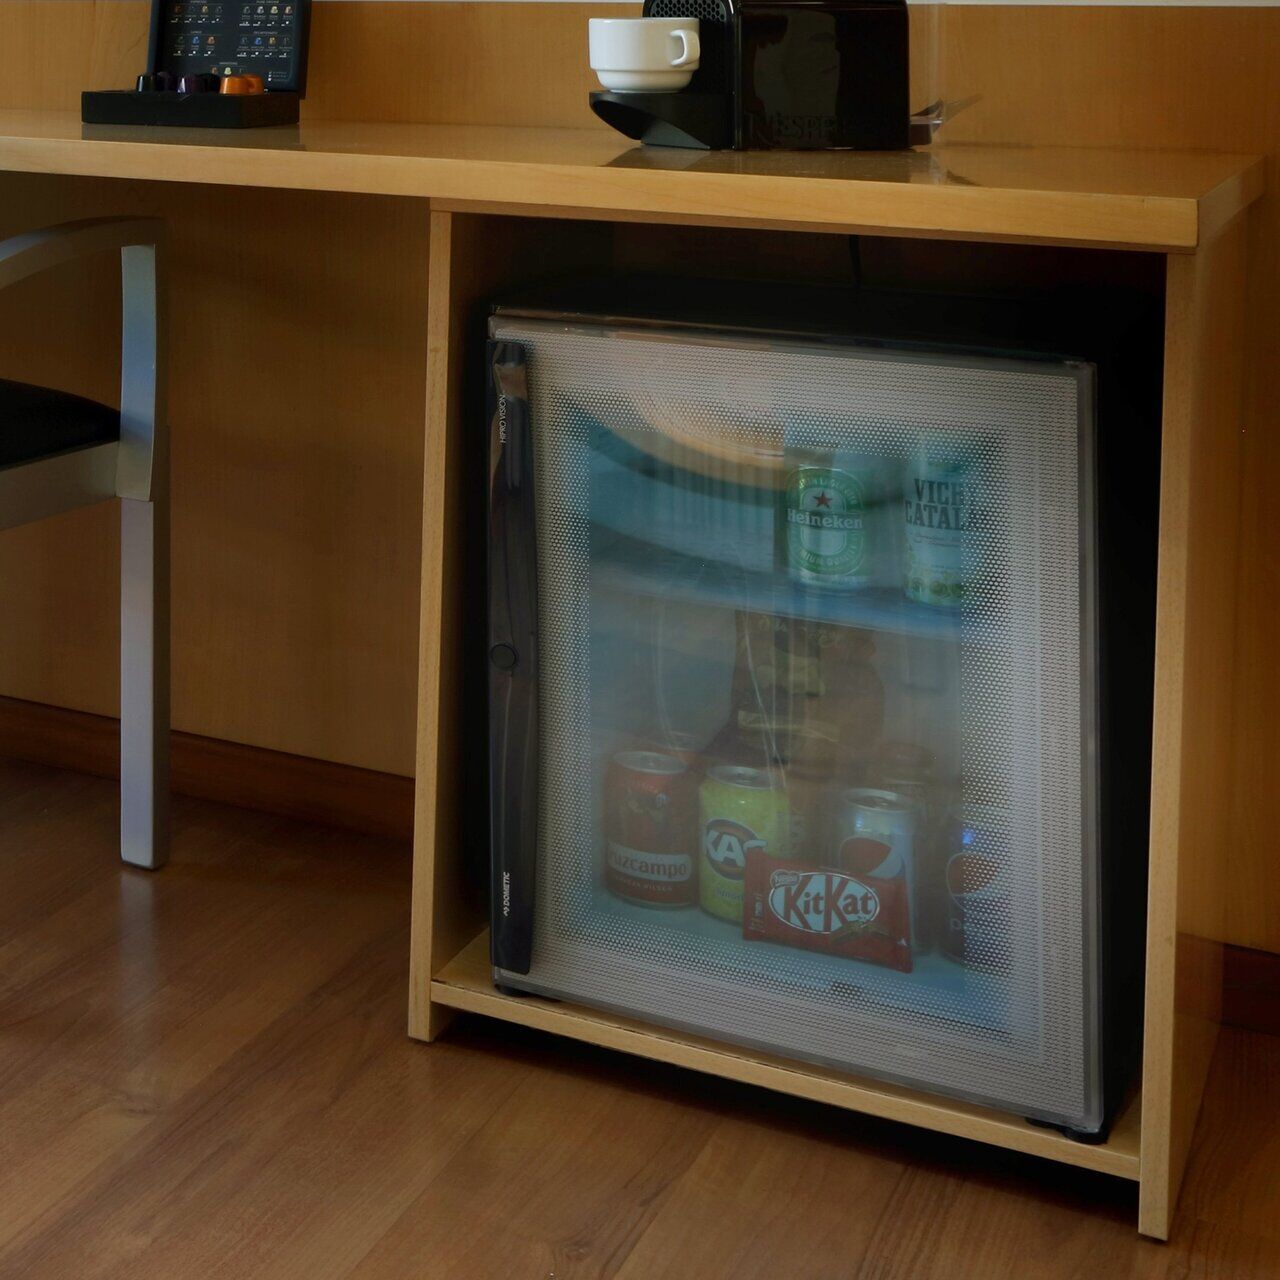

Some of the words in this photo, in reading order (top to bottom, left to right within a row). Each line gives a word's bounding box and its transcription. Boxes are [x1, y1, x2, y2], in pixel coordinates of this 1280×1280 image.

[787, 508, 863, 529] Heineken
[502, 870, 511, 907] DOMETIC
[783, 873, 872, 932] KitKat
